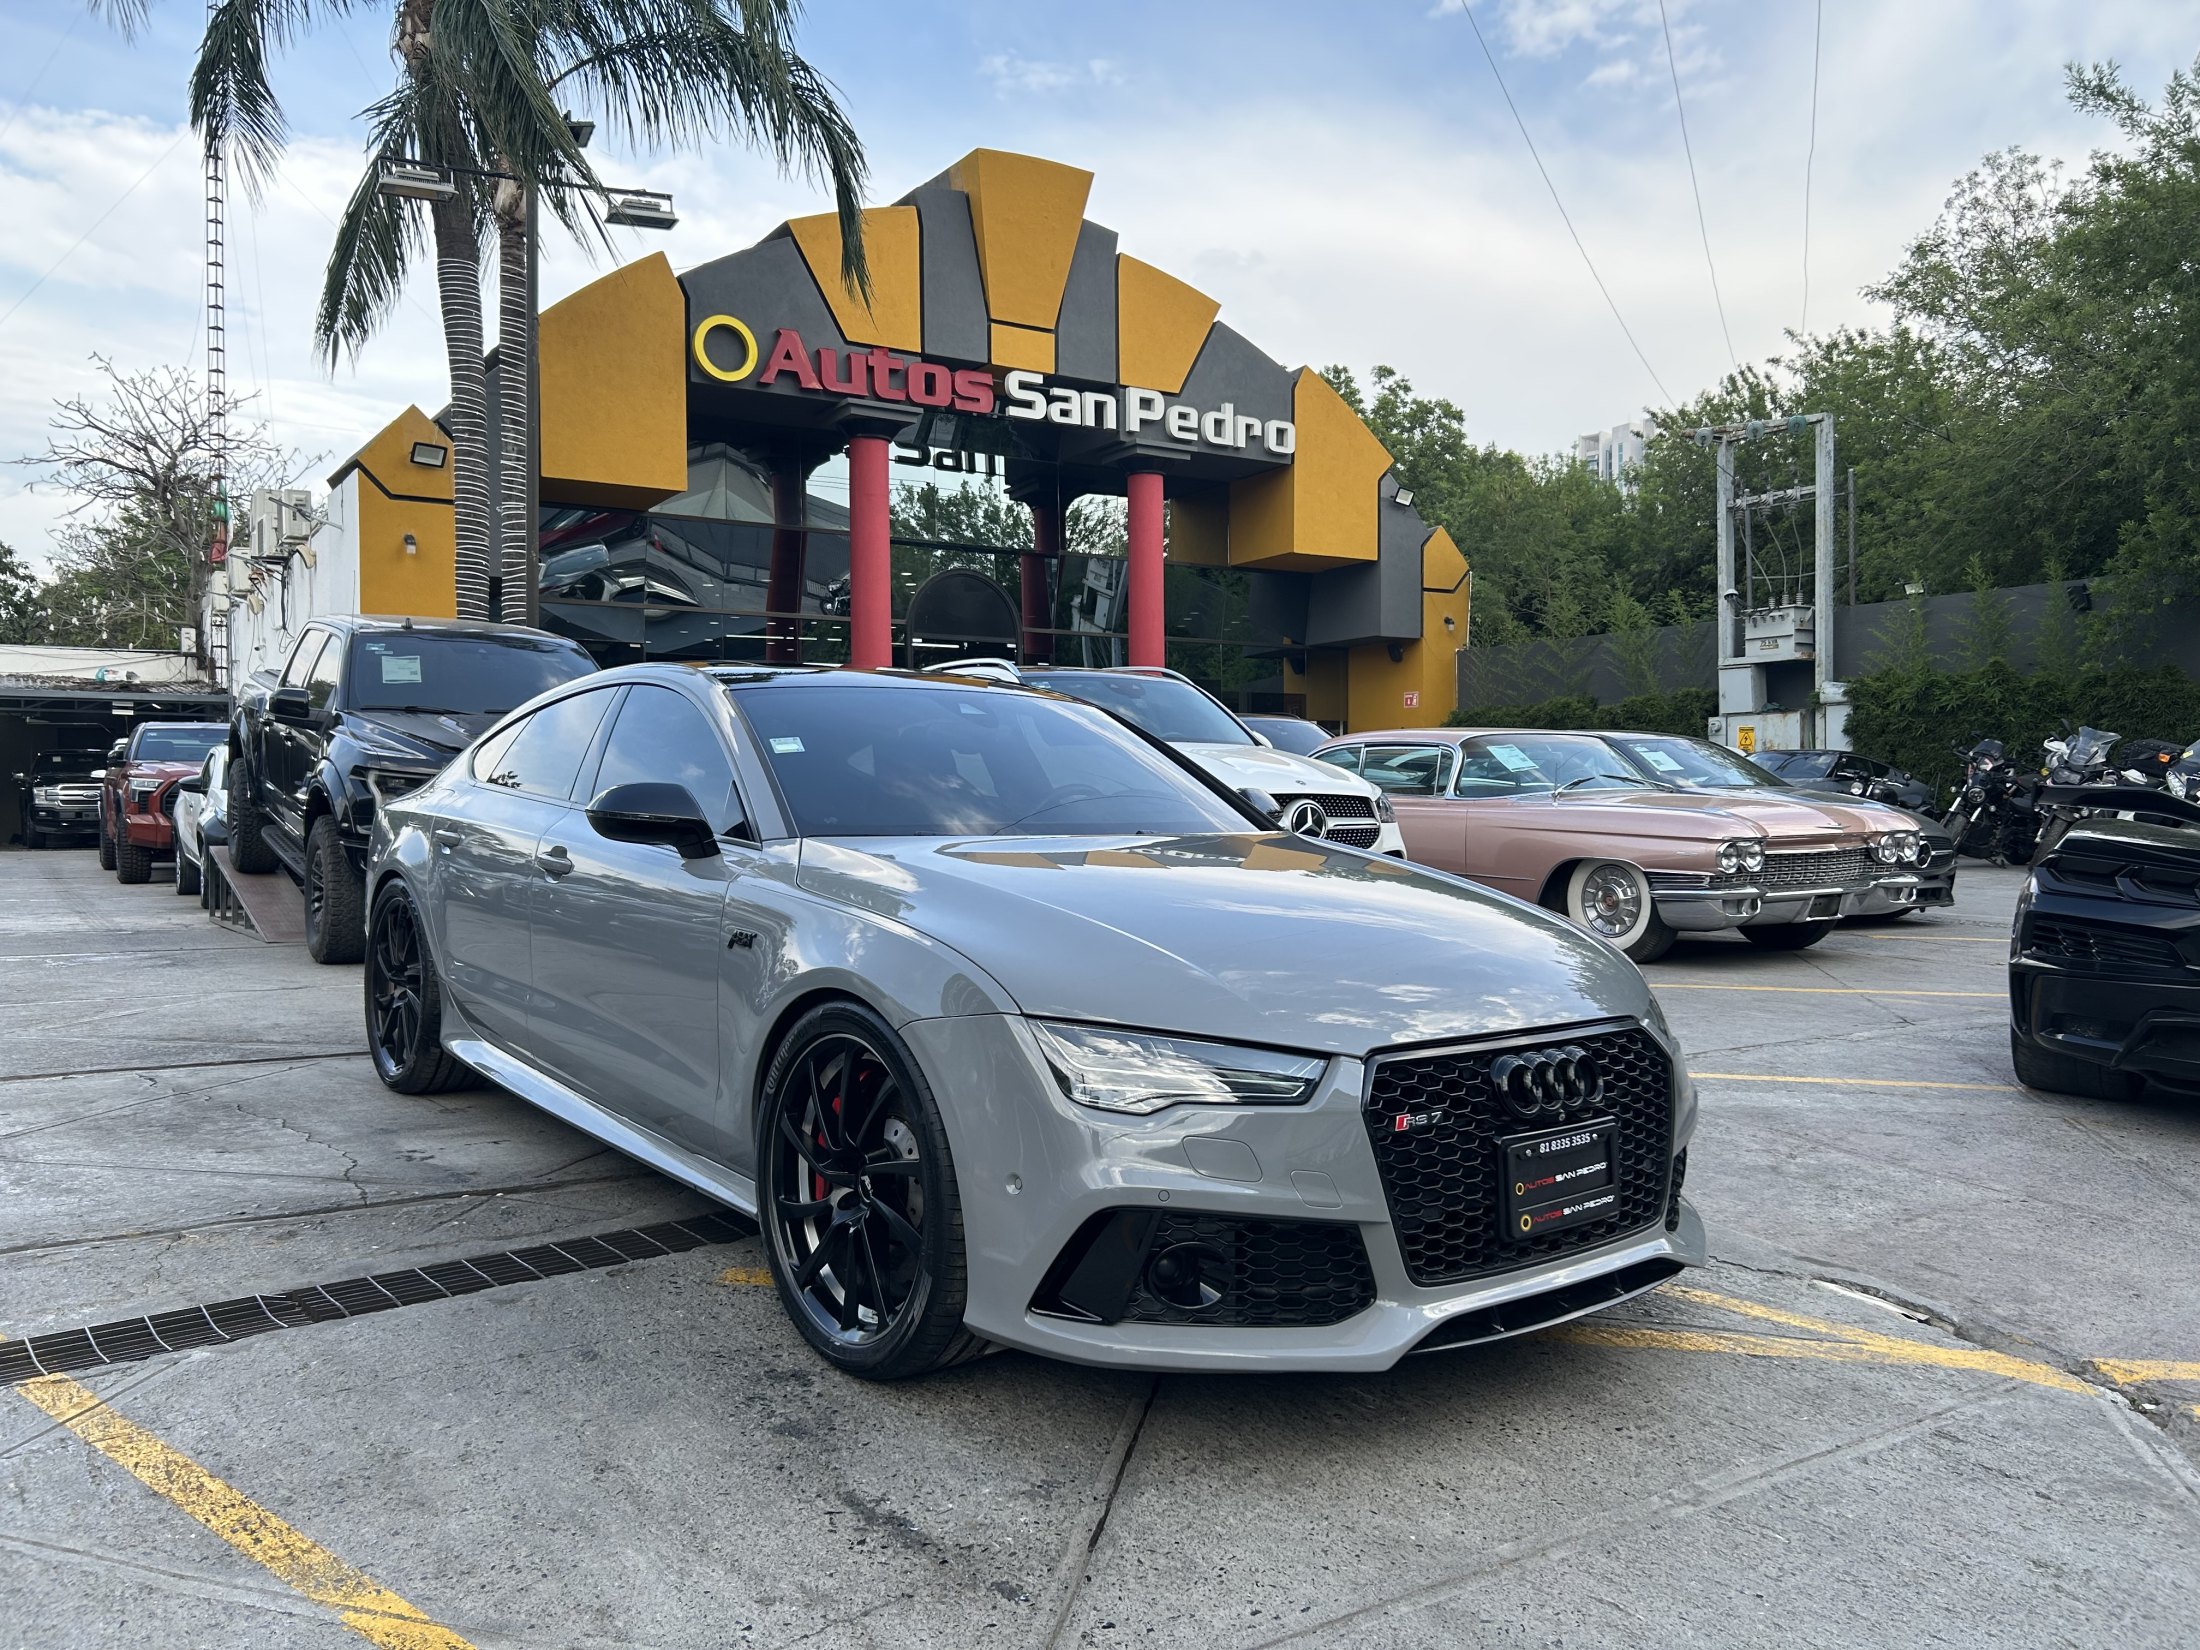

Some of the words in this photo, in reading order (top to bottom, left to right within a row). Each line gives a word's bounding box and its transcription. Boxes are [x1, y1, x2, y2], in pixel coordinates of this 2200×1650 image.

[758, 328, 994, 414] Autos
[1004, 370, 1117, 430] San
[1125, 387, 1296, 454] Pedro
[1540, 1142, 1550, 1153] 81
[1551, 1137, 1571, 1151] 8335
[1571, 1133, 1591, 1147] 3535
[1555, 1170, 1576, 1182] SAN
[1563, 1203, 1583, 1216] SAN
